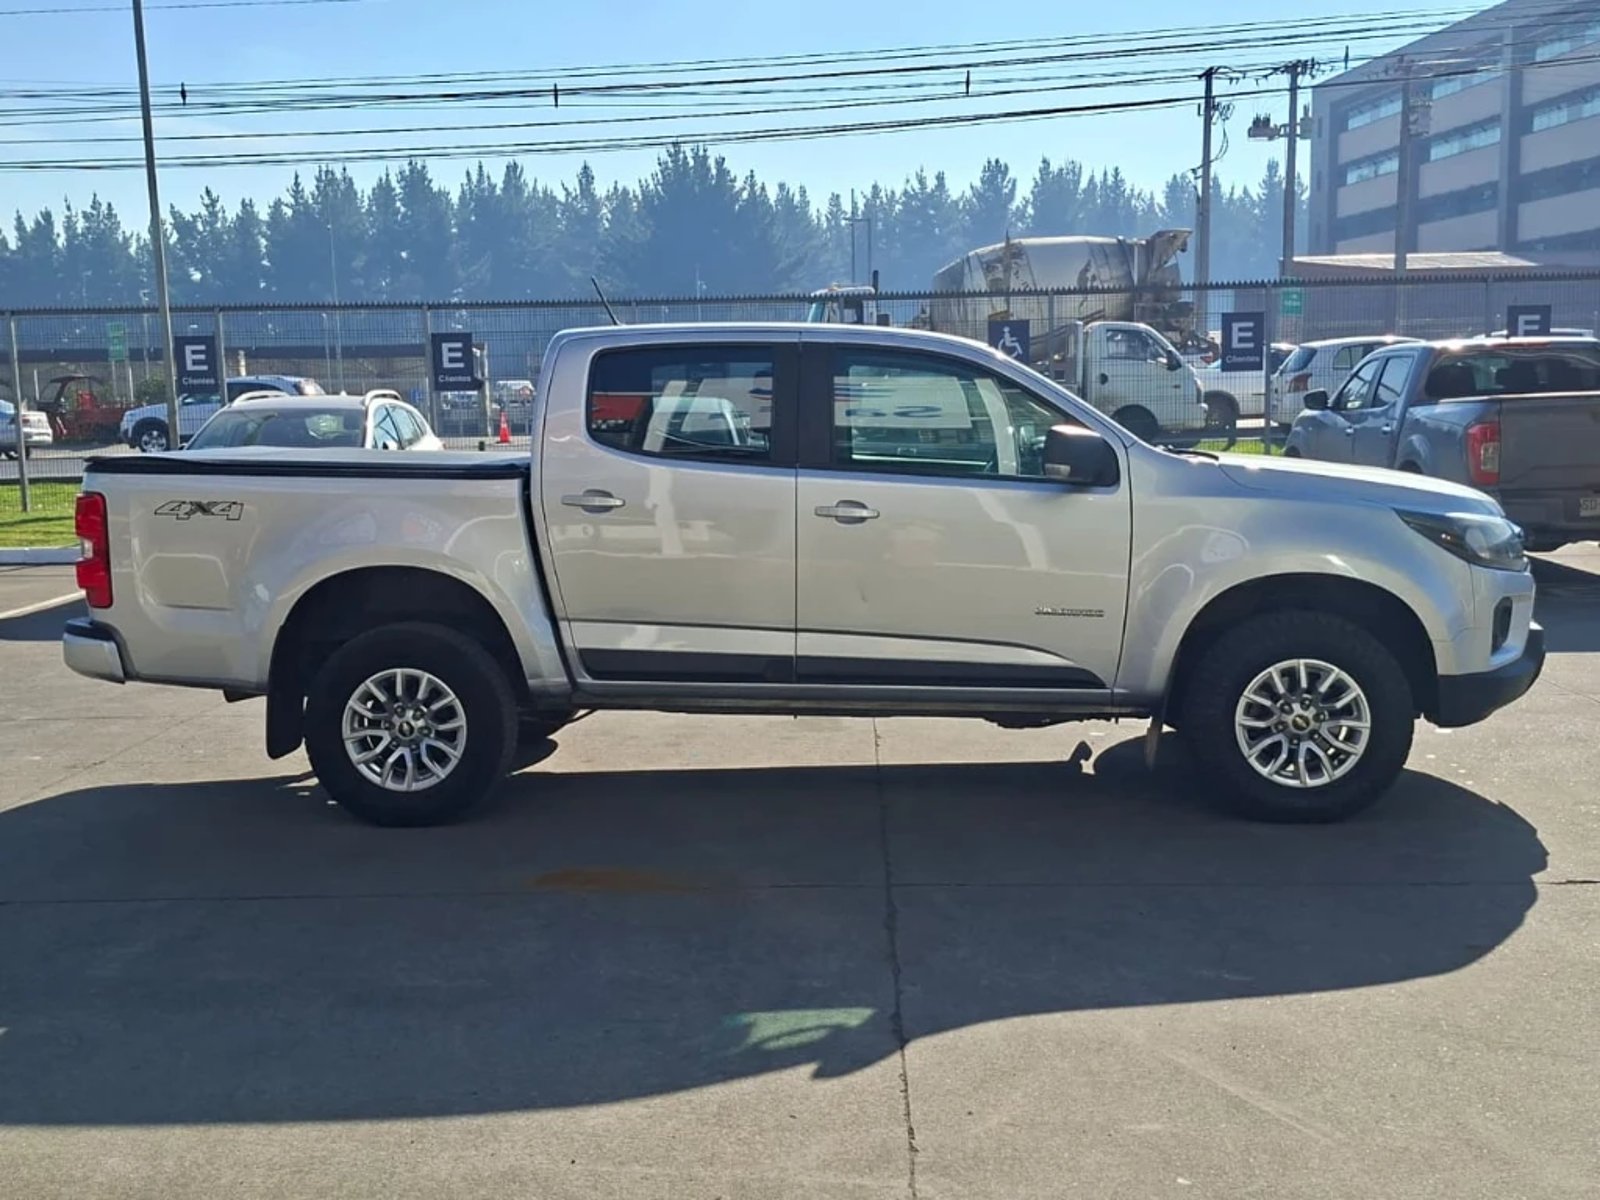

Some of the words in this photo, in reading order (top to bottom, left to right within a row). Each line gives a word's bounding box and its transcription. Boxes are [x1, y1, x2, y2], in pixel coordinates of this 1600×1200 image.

[1231, 322, 1254, 349] E
[185, 344, 209, 371] E
[442, 342, 465, 368] E
